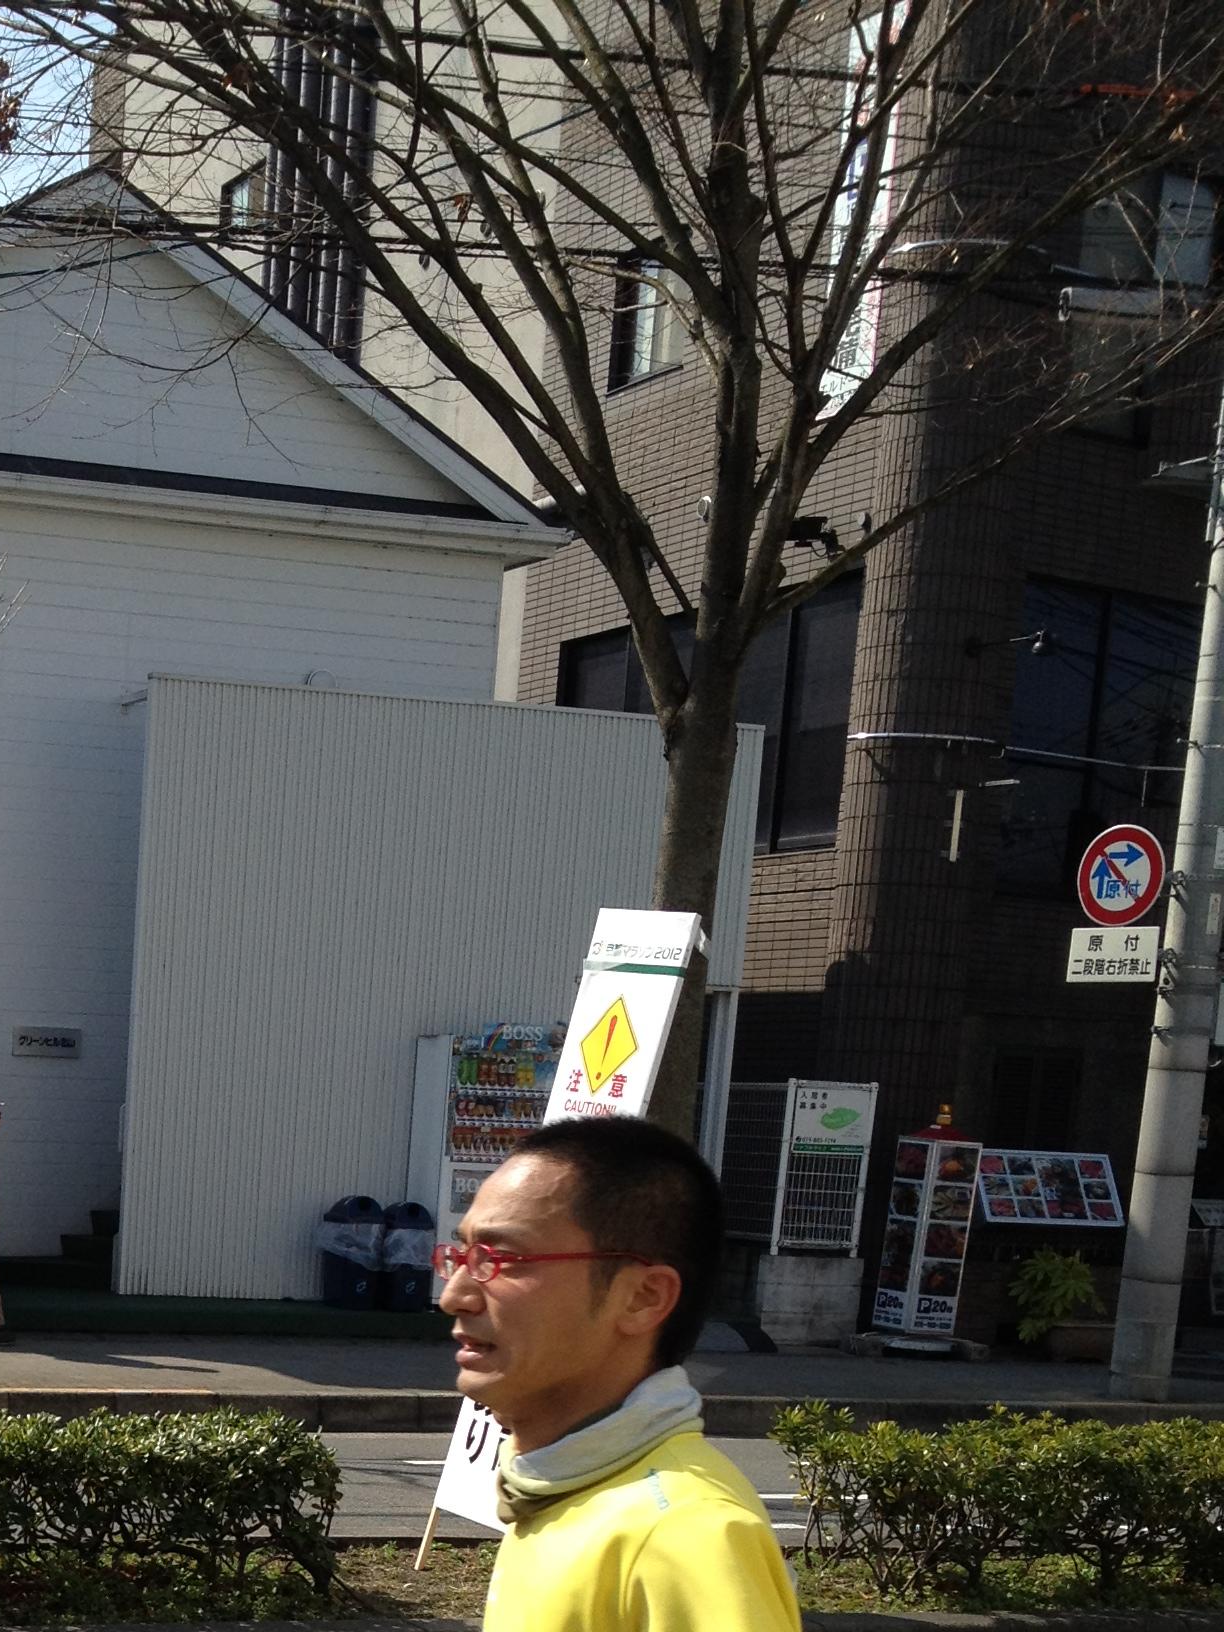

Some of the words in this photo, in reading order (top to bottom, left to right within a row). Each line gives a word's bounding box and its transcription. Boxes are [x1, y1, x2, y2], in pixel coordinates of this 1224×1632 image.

[1071, 958, 1151, 976] 二段階右折禁止
[502, 1024, 543, 1042] BOSS
